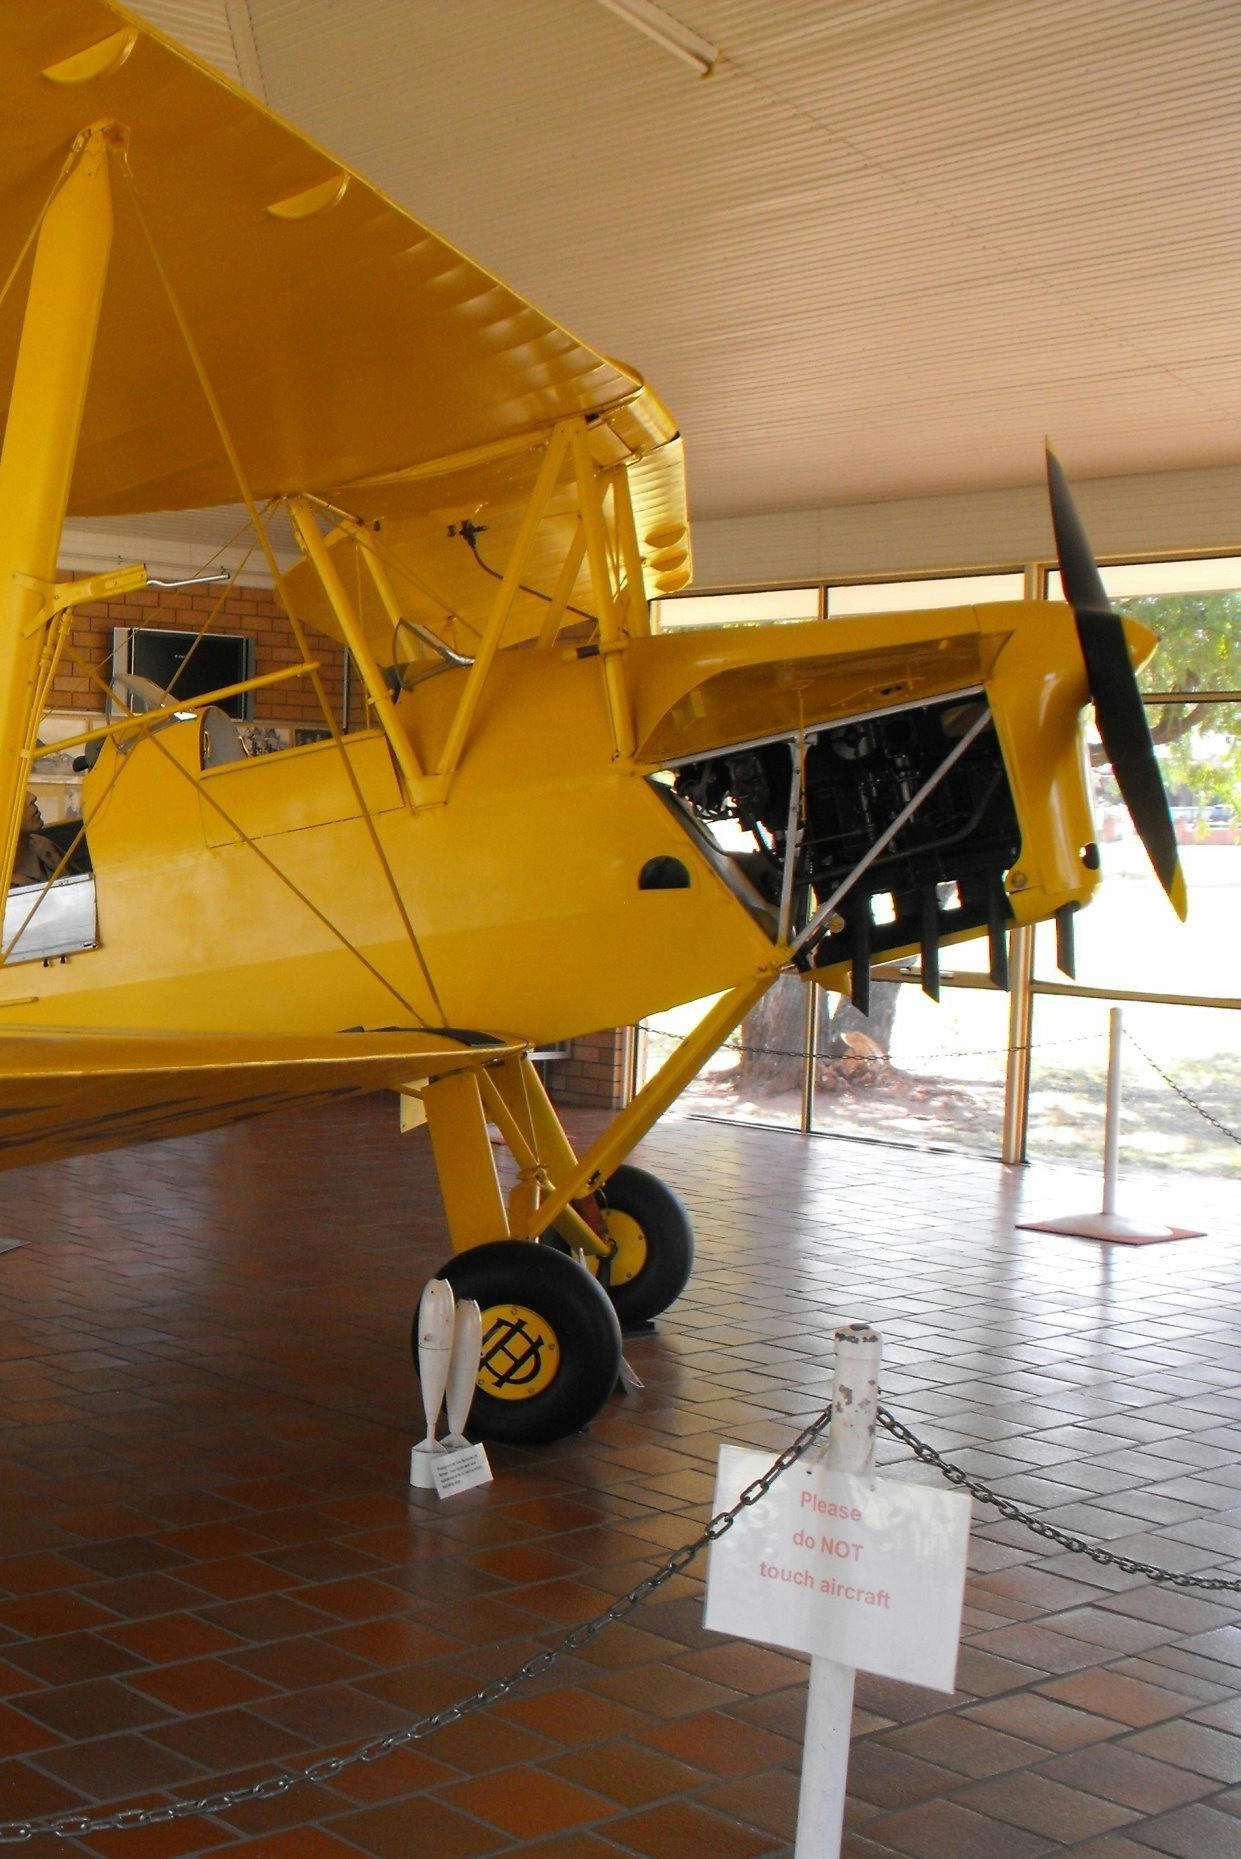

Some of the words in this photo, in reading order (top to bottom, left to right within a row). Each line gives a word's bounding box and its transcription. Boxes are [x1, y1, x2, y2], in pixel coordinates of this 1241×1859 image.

[800, 1491, 862, 1522] Please
[793, 1530, 816, 1551] do
[821, 1536, 864, 1561] NOT
[759, 1562, 814, 1588] touch
[820, 1578, 891, 1608] aircraft
